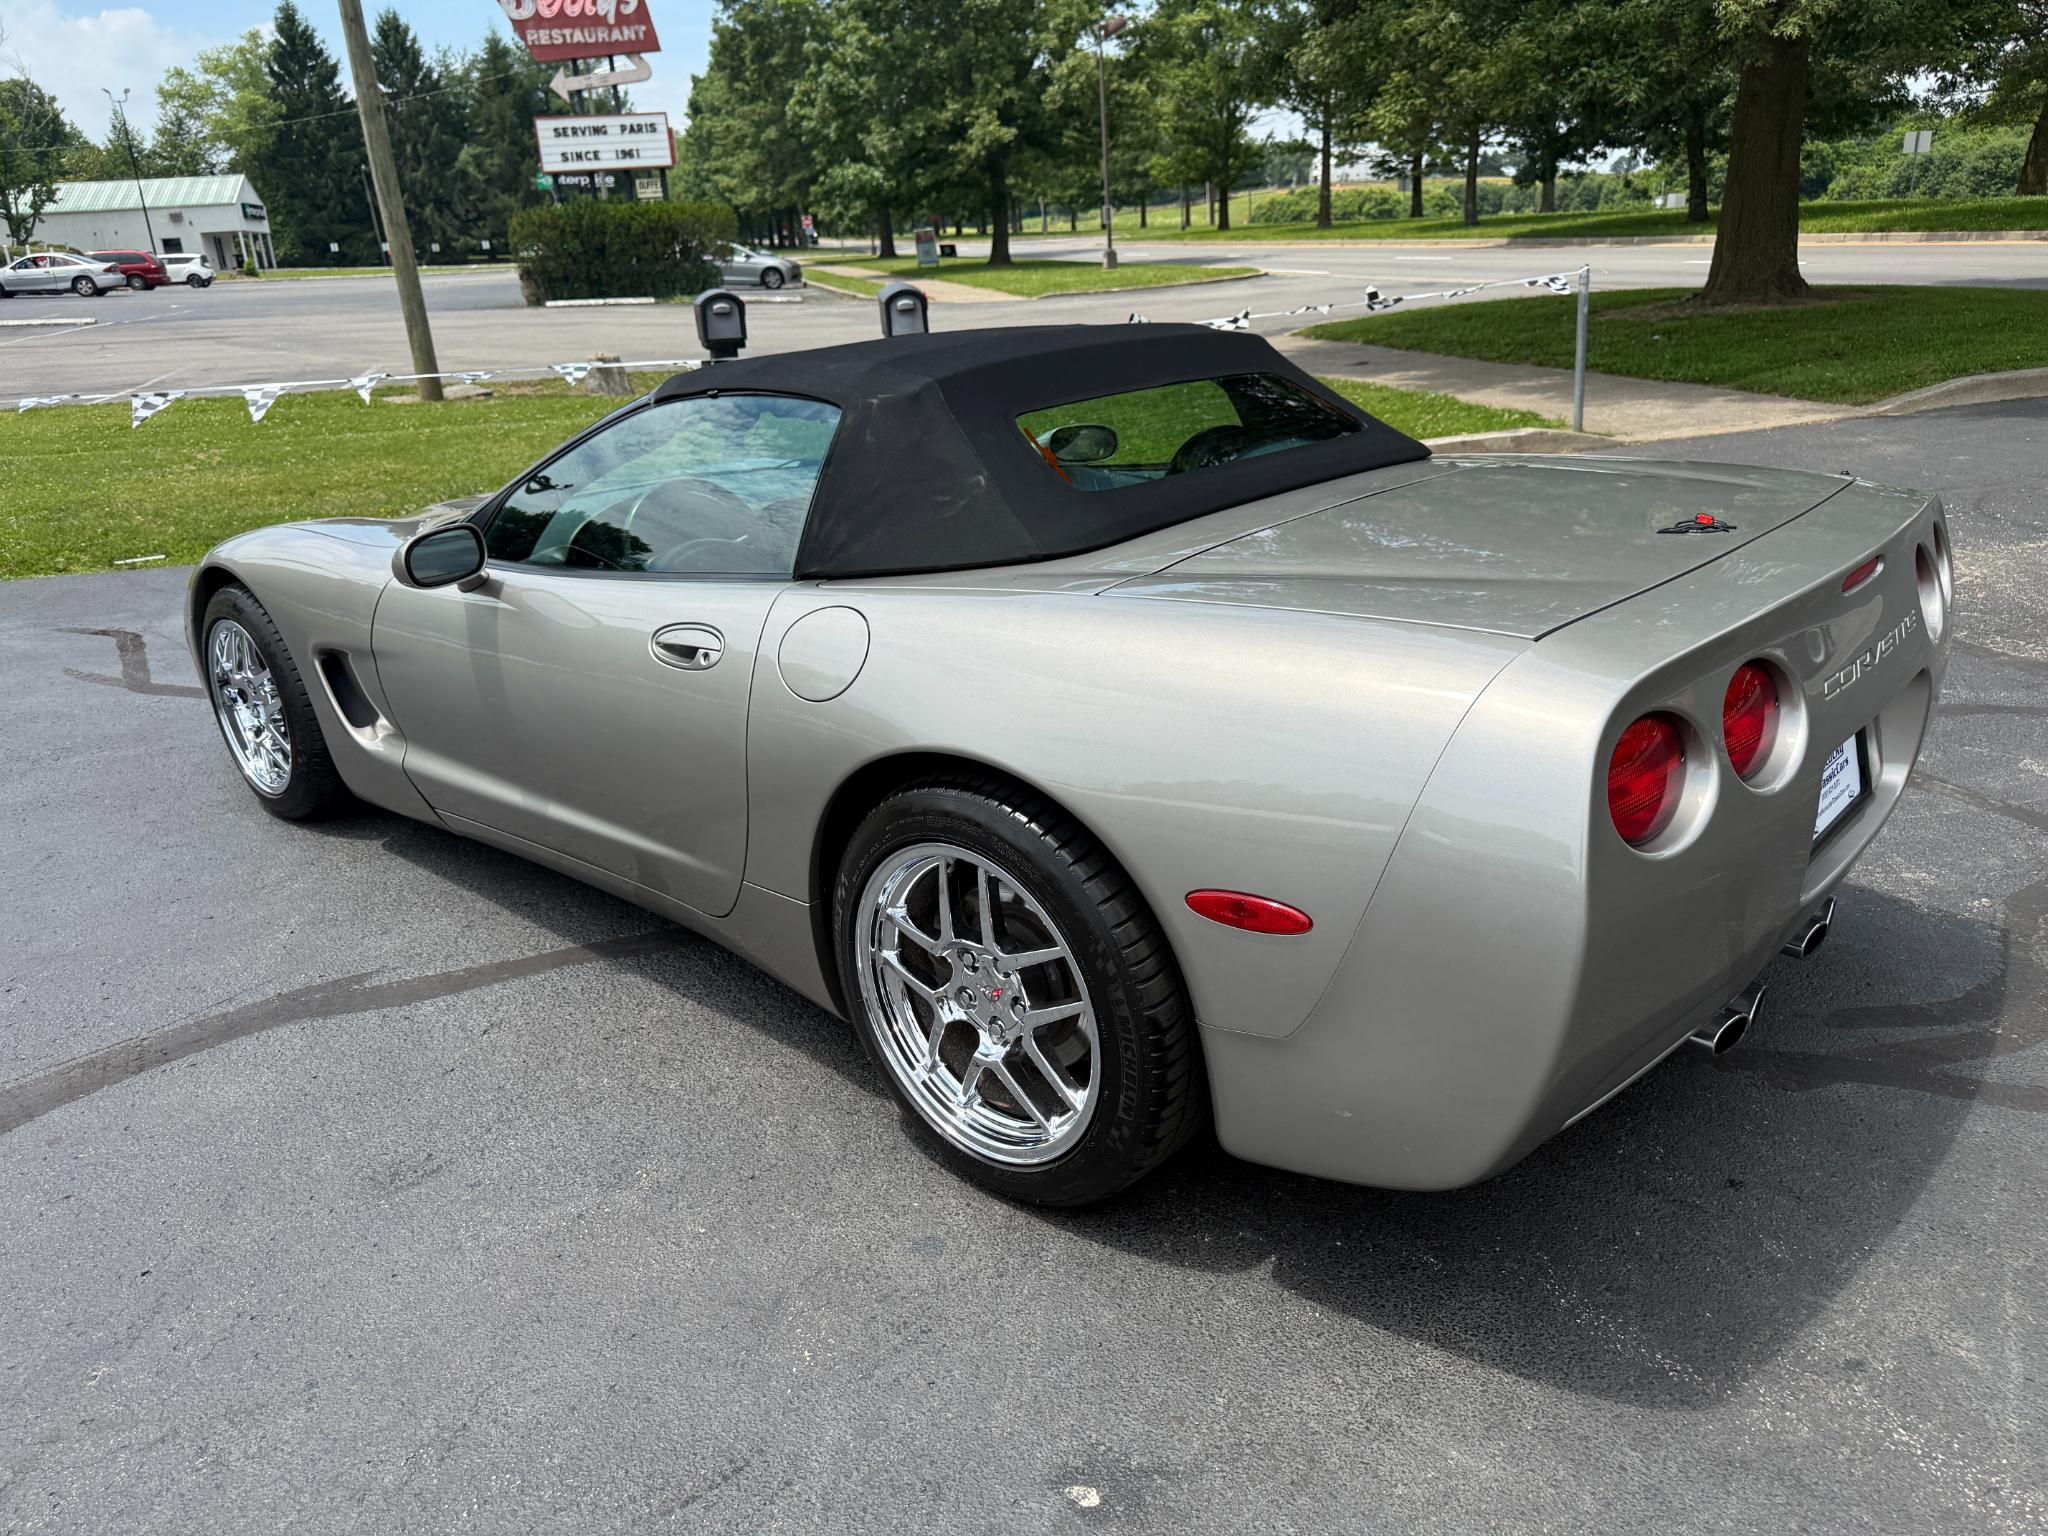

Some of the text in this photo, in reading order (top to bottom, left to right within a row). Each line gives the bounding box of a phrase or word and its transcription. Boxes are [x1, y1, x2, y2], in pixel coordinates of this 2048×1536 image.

[525, 24, 648, 46] RESTAURANT
[553, 122, 658, 138] SERVING PARIS
[561, 148, 640, 162] SINCE 1961
[1824, 608, 1917, 701] CORVETTE
[1117, 1015, 1138, 1120] MICHELIN
